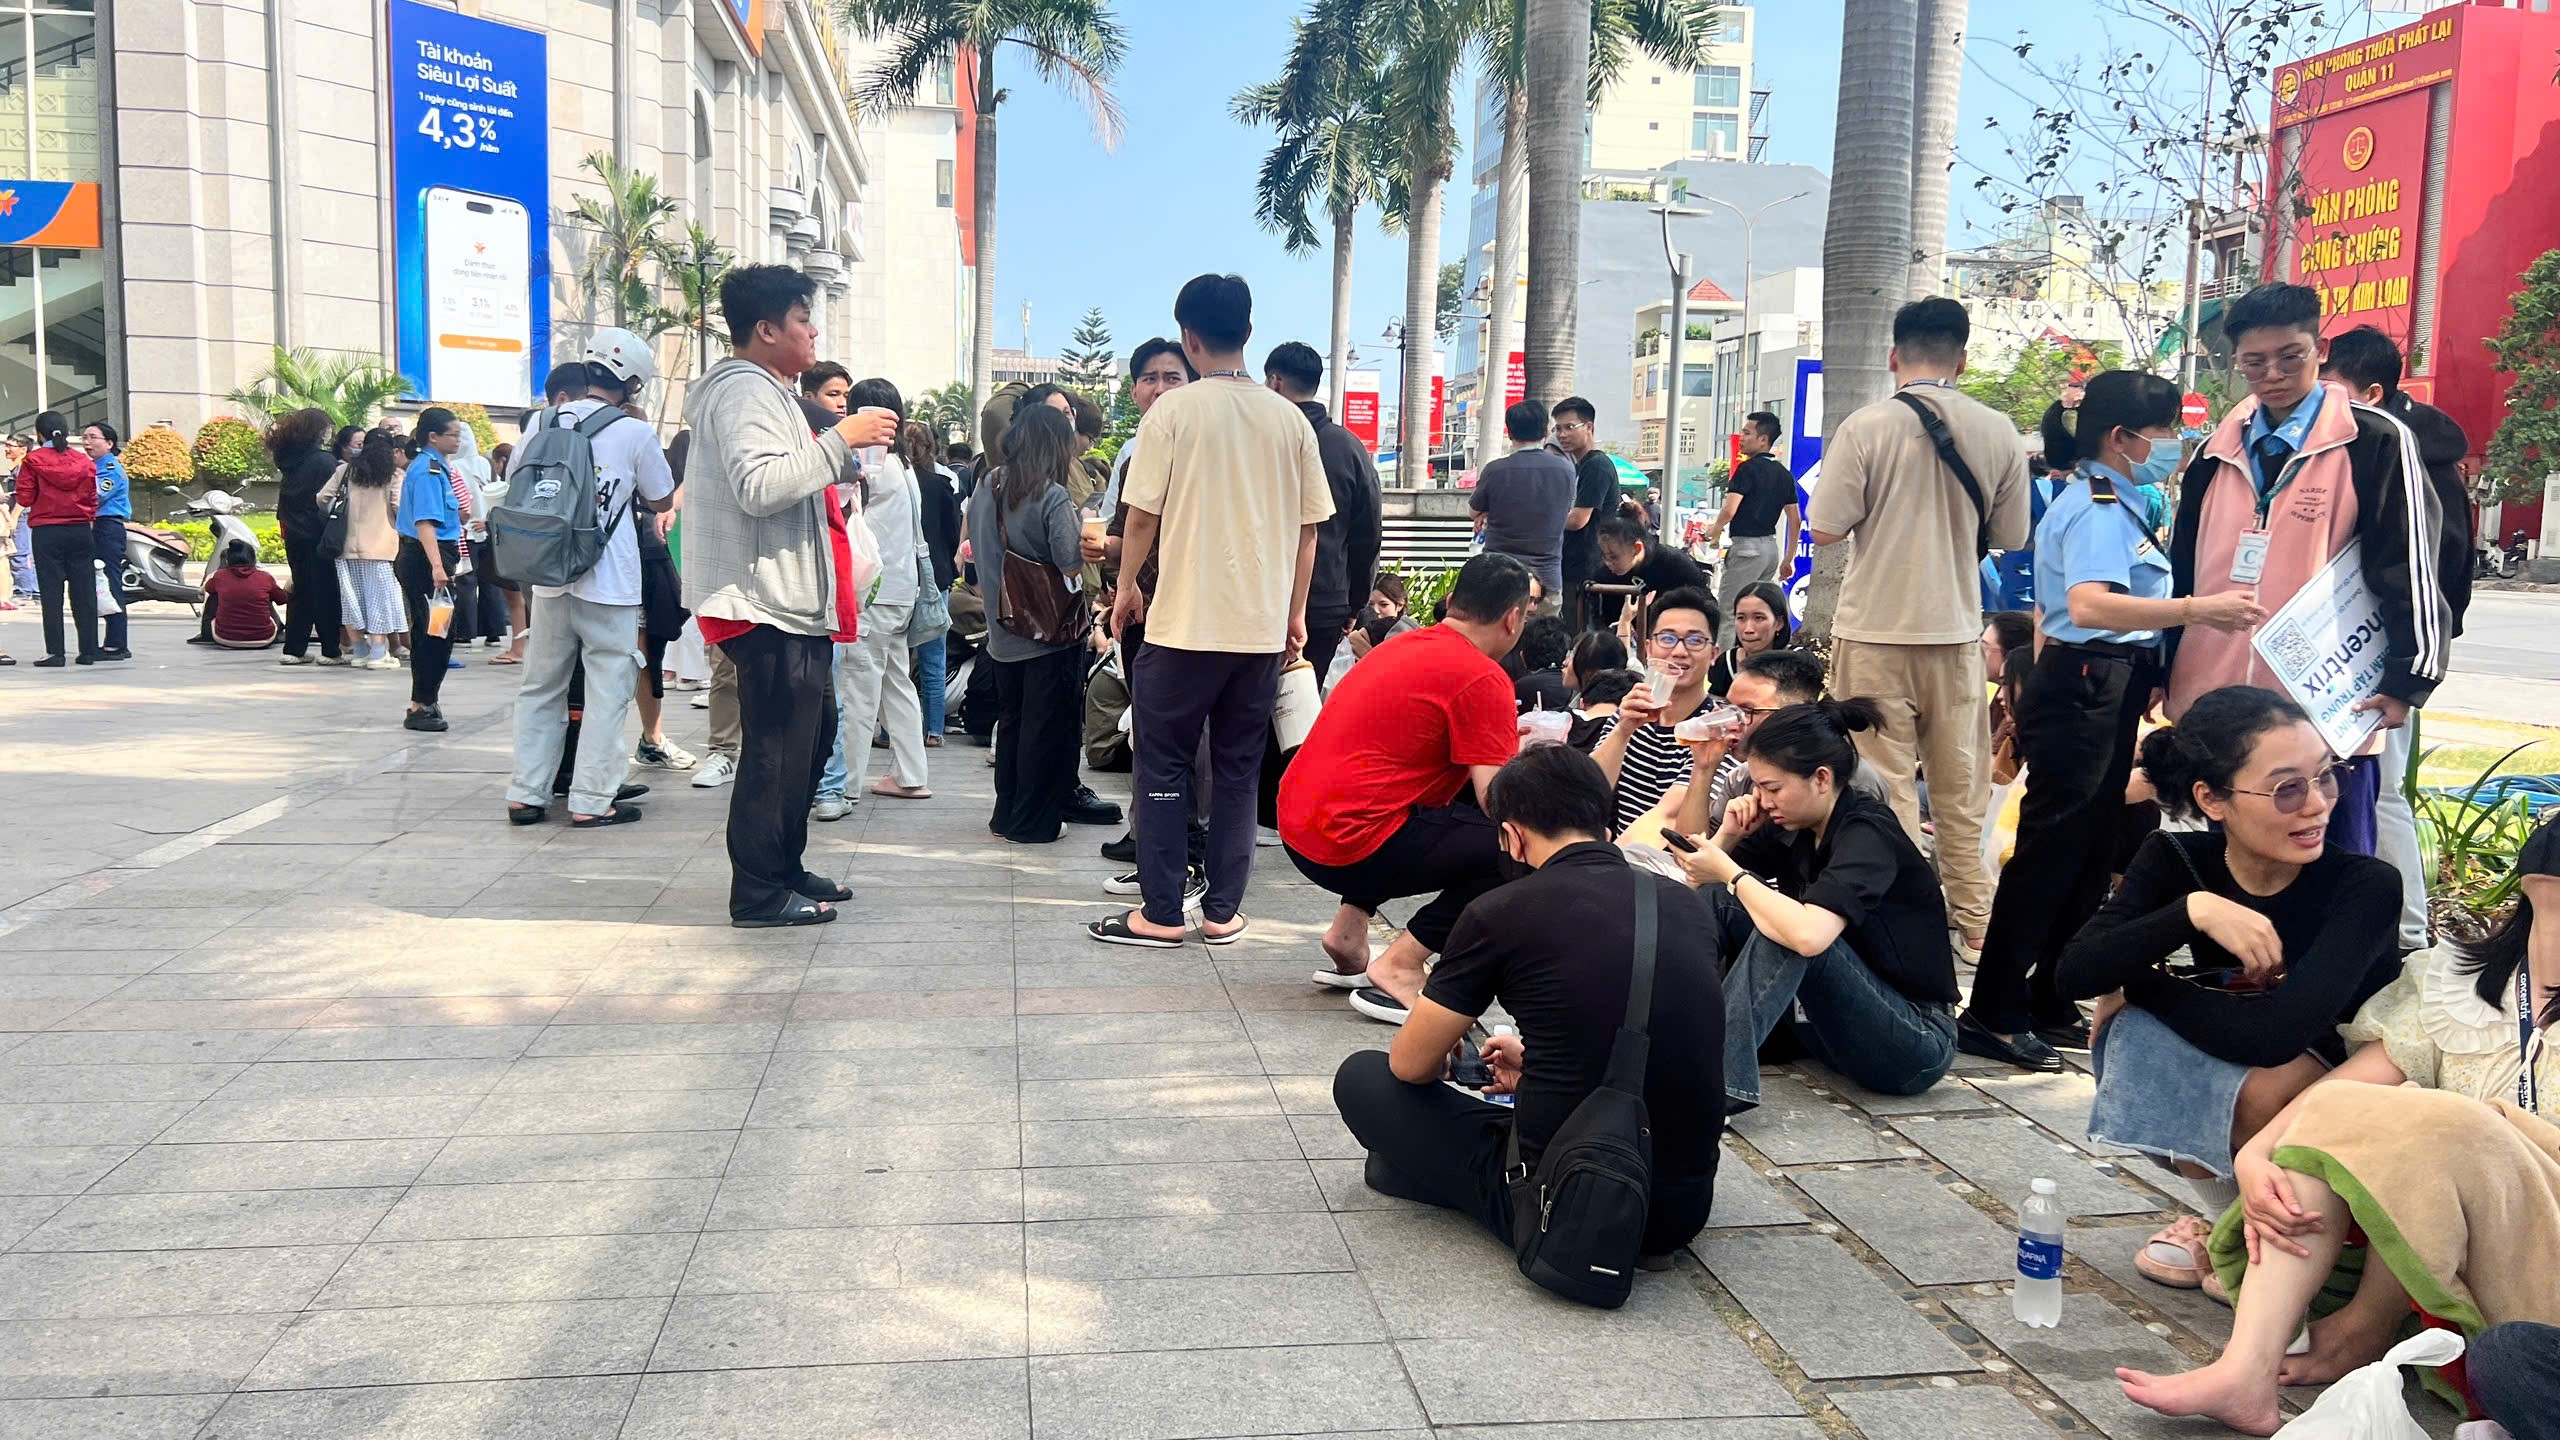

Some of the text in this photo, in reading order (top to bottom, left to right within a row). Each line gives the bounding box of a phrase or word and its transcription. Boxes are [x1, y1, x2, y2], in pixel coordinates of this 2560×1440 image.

[416, 40, 493, 72] Tài khoản
[2302, 18, 2453, 83] VĂN PHÒNG THỪA PHÁT LẠI
[417, 63, 518, 99] Siêu Lợi Suất
[2345, 67, 2377, 93] QUẬN
[2380, 63, 2395, 82] 11
[418, 91, 424, 101] 1
[425, 95, 446, 107] ngày
[446, 98, 468, 111] cũng
[469, 102, 487, 113] sinh
[498, 107, 514, 118] đến
[479, 142, 500, 154] /năm
[2312, 176, 2400, 227] VĂN PHÒNG
[2333, 285, 2350, 318] THỊ
[2352, 280, 2377, 312] KIM
[2377, 275, 2409, 309] LOAN
[2244, 549, 2258, 565] C
[2301, 608, 2386, 699] ncentrix
[2353, 669, 2374, 692] TẬP
[2319, 687, 2356, 725] TRUNG
[2520, 972, 2531, 1021] concentrix
